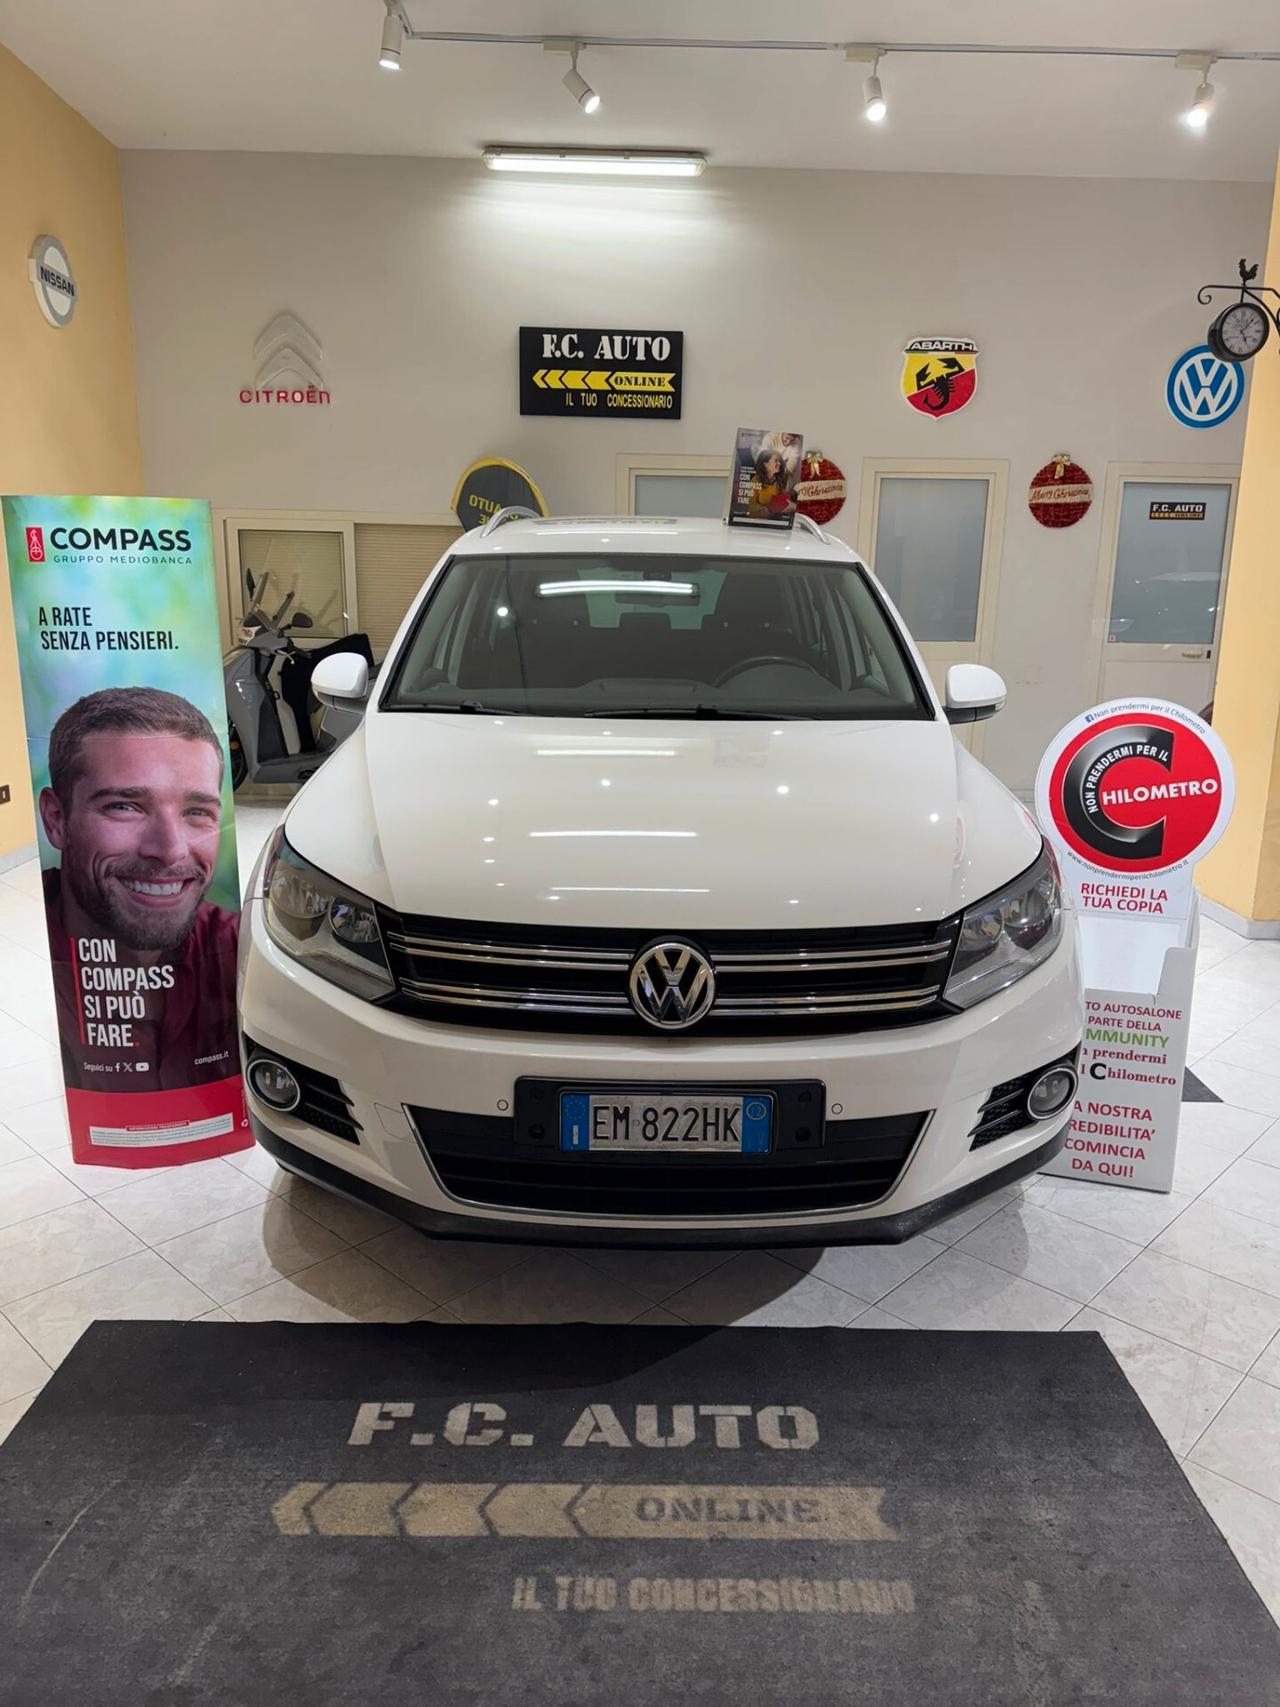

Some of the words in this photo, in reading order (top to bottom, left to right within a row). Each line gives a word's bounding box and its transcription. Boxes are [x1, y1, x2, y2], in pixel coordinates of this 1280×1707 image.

[40, 265, 75, 297] NISSAN
[542, 333, 585, 359] F.C.
[593, 335, 671, 361] AUTO
[907, 339, 978, 352] ABARTH
[614, 375, 666, 387] ONLINE
[565, 393, 574, 406] IL
[581, 393, 598, 406] TUO
[607, 394, 673, 409] CONCESSIONARIO
[1174, 504, 1203, 512] AUTO
[49, 527, 192, 552] COMPASS
[53, 555, 104, 564] GRUPPO
[110, 555, 192, 565] MEDIOBANCA
[39, 606, 48, 626] A
[52, 606, 93, 627] RATE
[40, 631, 92, 651] SENZA
[96, 631, 179, 651] PENSIERI.
[1110, 703, 1149, 714] prendermi
[1150, 704, 1163, 712] per
[1136, 745, 1158, 757] PER
[1158, 749, 1168, 762] IL
[1086, 745, 1134, 789] PRENDERMI
[1084, 791, 1099, 814] NON
[1080, 882, 1145, 900] RICHIEDI
[1150, 888, 1168, 901] LA
[1082, 896, 1113, 910] TUA
[1117, 898, 1164, 914] COPIA
[79, 938, 116, 963] CON
[81, 965, 175, 991] COMPASS
[84, 995, 101, 1019] SI
[106, 991, 146, 1020] PUÒ
[1103, 1002, 1183, 1020] AUTOSALONE
[1088, 1014, 1124, 1029] PARTE
[1126, 1019, 1162, 1032] DELLA
[194, 1050, 230, 1066] compass.it
[1092, 1047, 1168, 1065] prendermi
[83, 1061, 104, 1072] Seguici
[105, 1064, 114, 1072] su
[1090, 1061, 1177, 1086] Chilometro
[1087, 1102, 1153, 1121] NOSTRA
[592, 1104, 631, 1141] EM
[641, 1106, 741, 1142] 822HK
[1064, 1137, 1146, 1161] COMINCIA
[1071, 1158, 1094, 1173] DA
[1098, 1162, 1134, 1178] QUI!
[347, 1402, 535, 1447] F.C.
[562, 1403, 820, 1450] AUTO
[634, 1496, 822, 1525] ONLINE
[511, 1576, 542, 1611] IL
[555, 1575, 616, 1612] TUO
